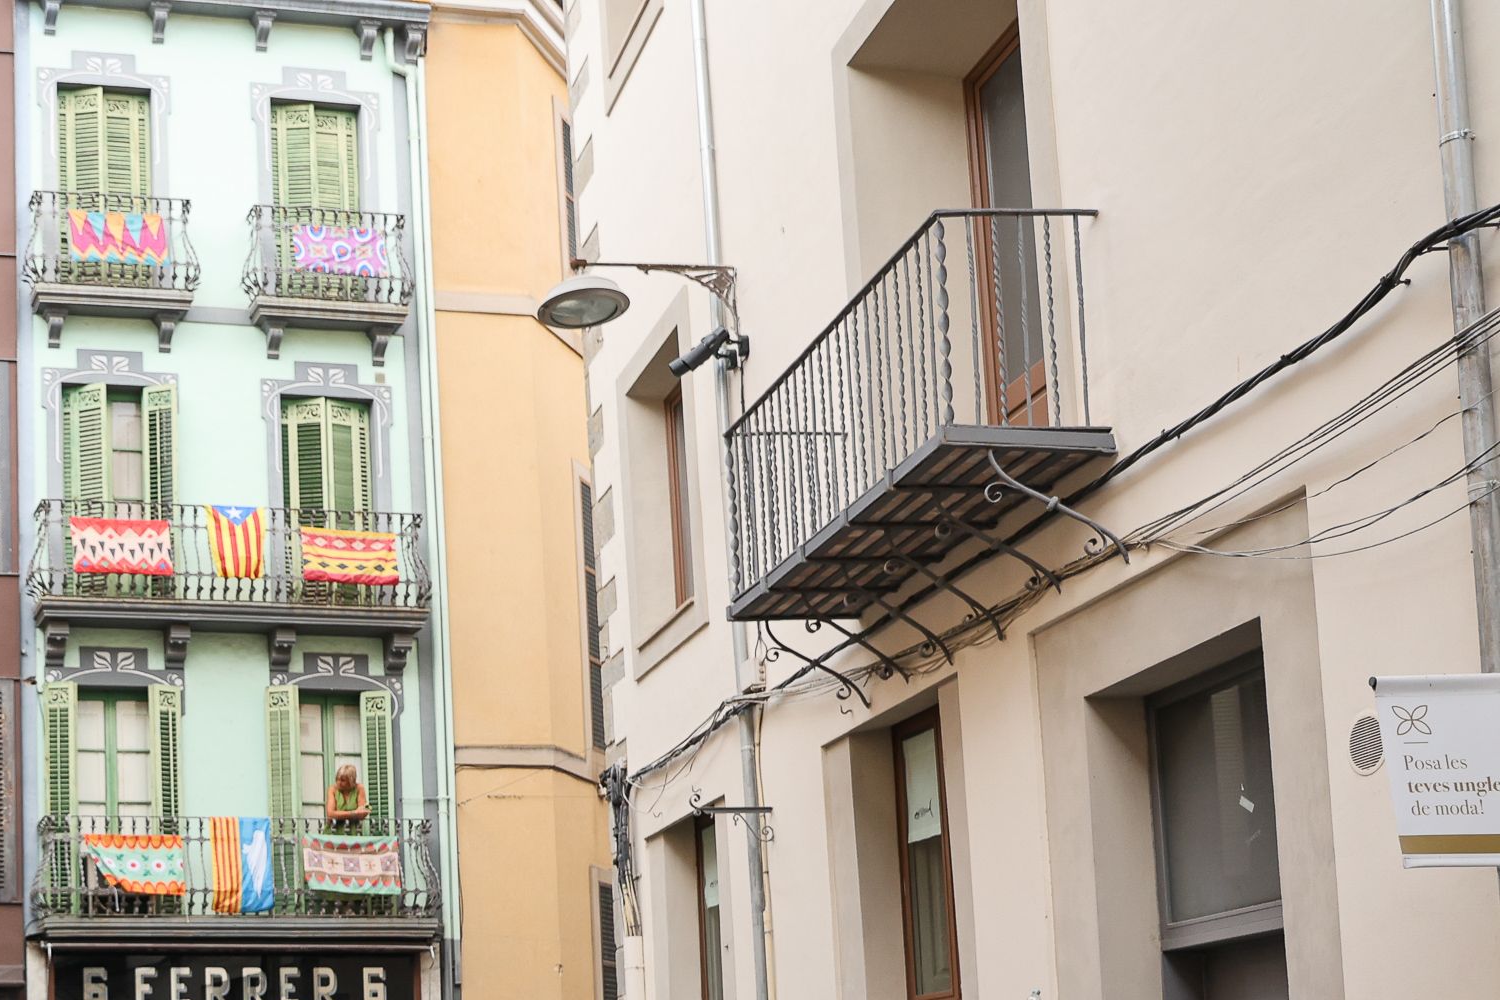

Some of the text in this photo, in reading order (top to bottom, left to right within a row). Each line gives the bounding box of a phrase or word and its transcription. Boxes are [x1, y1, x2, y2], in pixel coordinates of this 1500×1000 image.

[1403, 753, 1468, 771] Posa les
[1407, 779, 1450, 794] teves
[1411, 799, 1485, 816] de moda!
